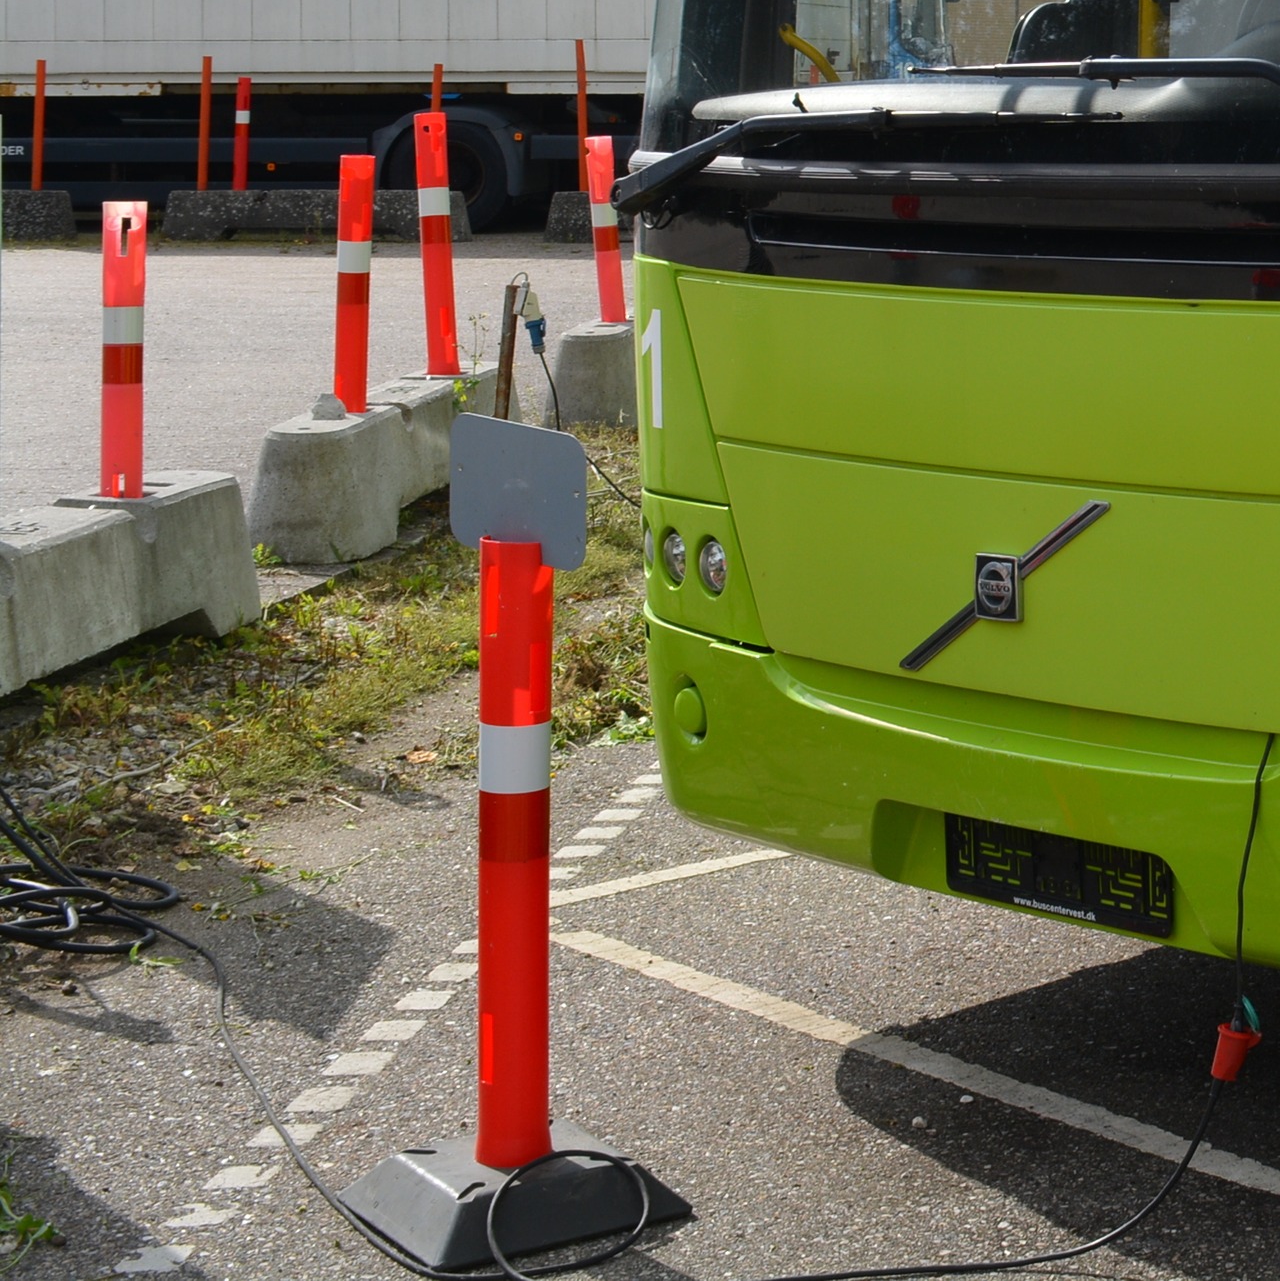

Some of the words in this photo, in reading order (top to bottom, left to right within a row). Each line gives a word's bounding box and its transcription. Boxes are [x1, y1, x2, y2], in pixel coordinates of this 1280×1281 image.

[641, 308, 664, 429] 1
[980, 582, 1010, 593] VOLVO
[1013, 895, 1097, 922] www.buscentervest.dk
